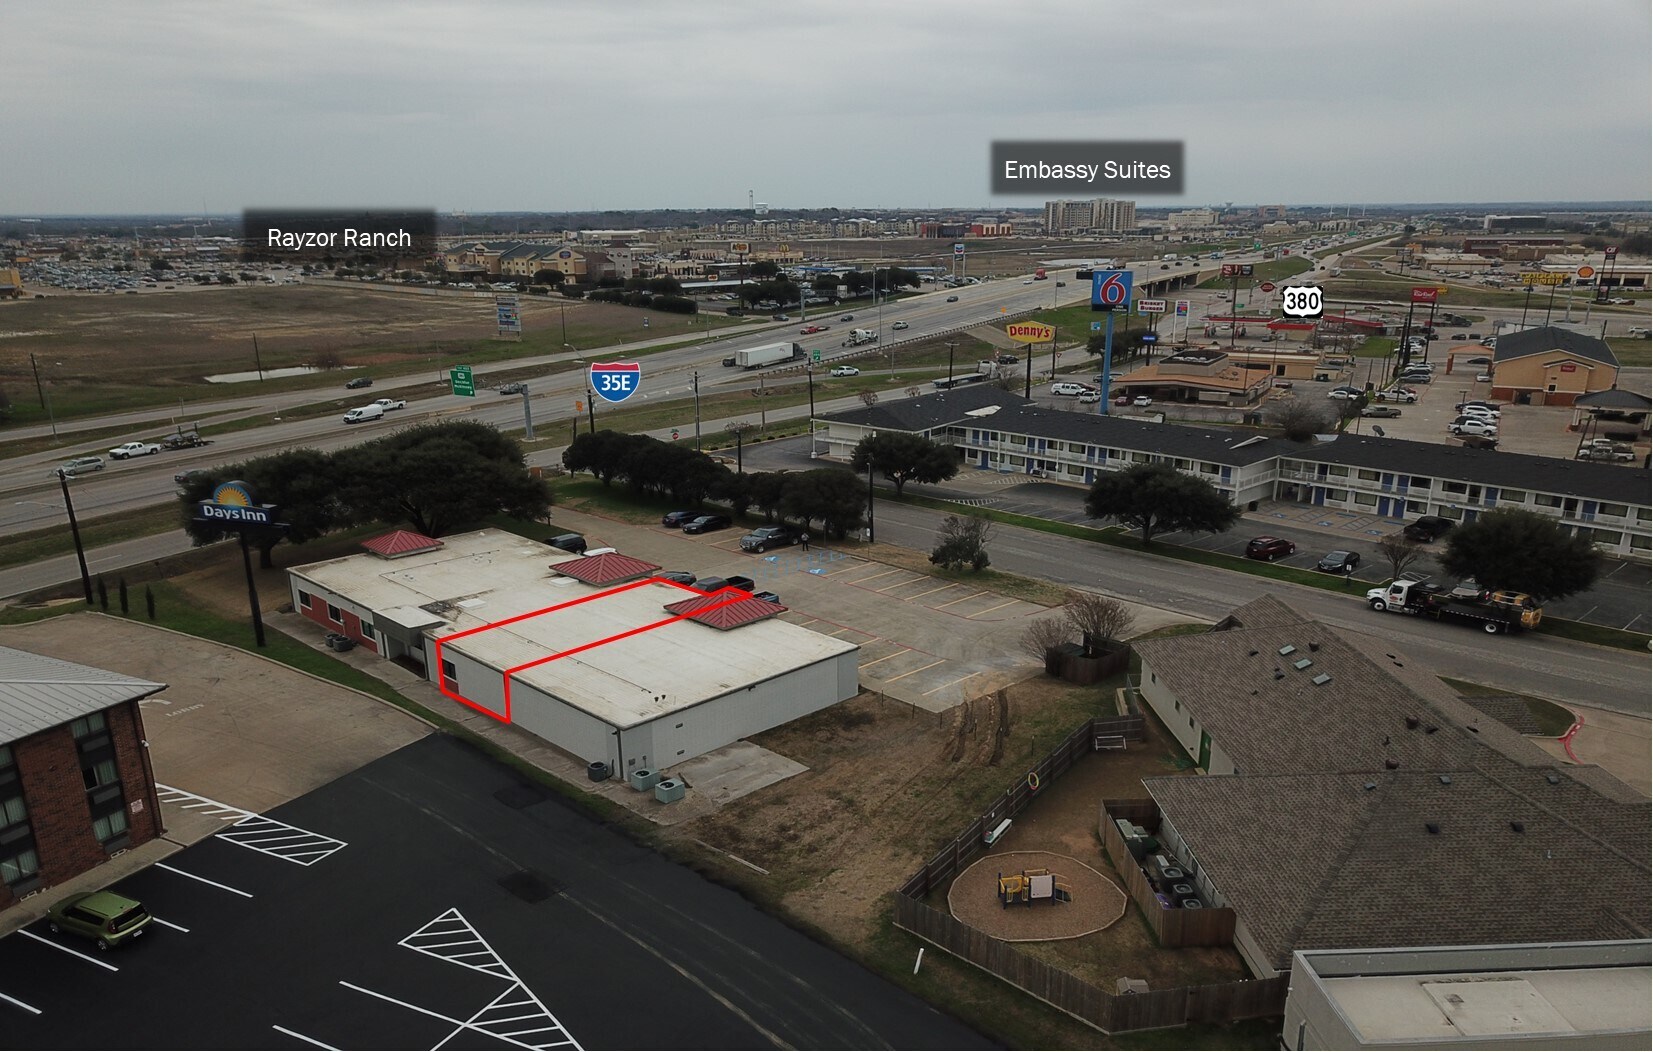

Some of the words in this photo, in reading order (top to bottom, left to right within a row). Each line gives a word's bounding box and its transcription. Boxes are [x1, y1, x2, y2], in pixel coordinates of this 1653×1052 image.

[1100, 272, 1127, 305] 6
[1009, 326, 1051, 338] Denny's
[203, 505, 240, 520] Days
[241, 508, 267, 522] Inn
